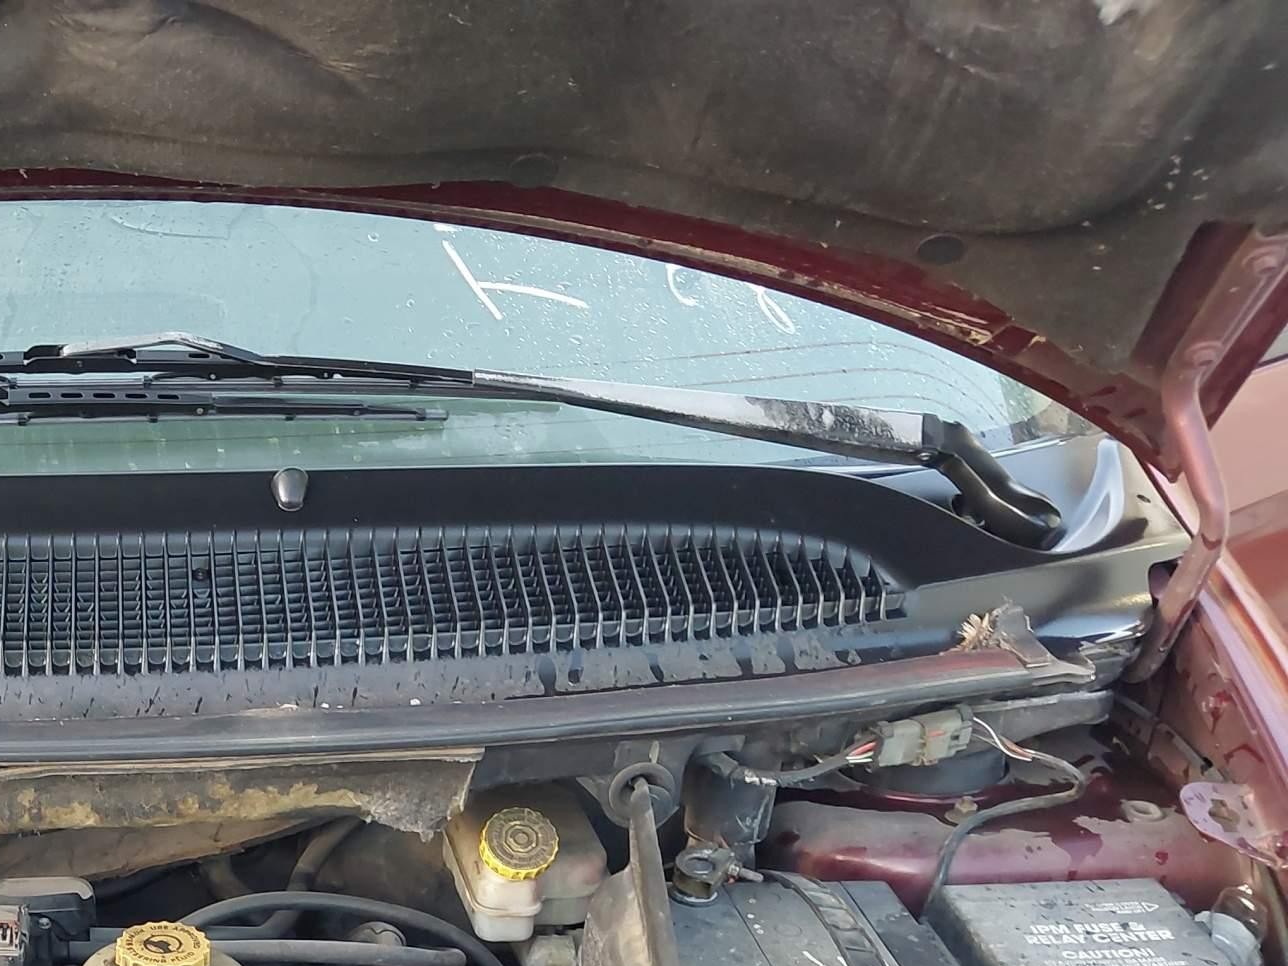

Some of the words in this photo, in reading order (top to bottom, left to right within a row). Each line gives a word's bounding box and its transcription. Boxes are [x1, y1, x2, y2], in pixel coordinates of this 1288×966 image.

[1030, 924, 1069, 934] IPM
[1075, 922, 1124, 934] FUSE
[1127, 922, 1146, 931] &
[1025, 933, 1088, 945] RELAY
[1093, 929, 1175, 942] CENTER
[1061, 948, 1155, 960] CAUTION!
